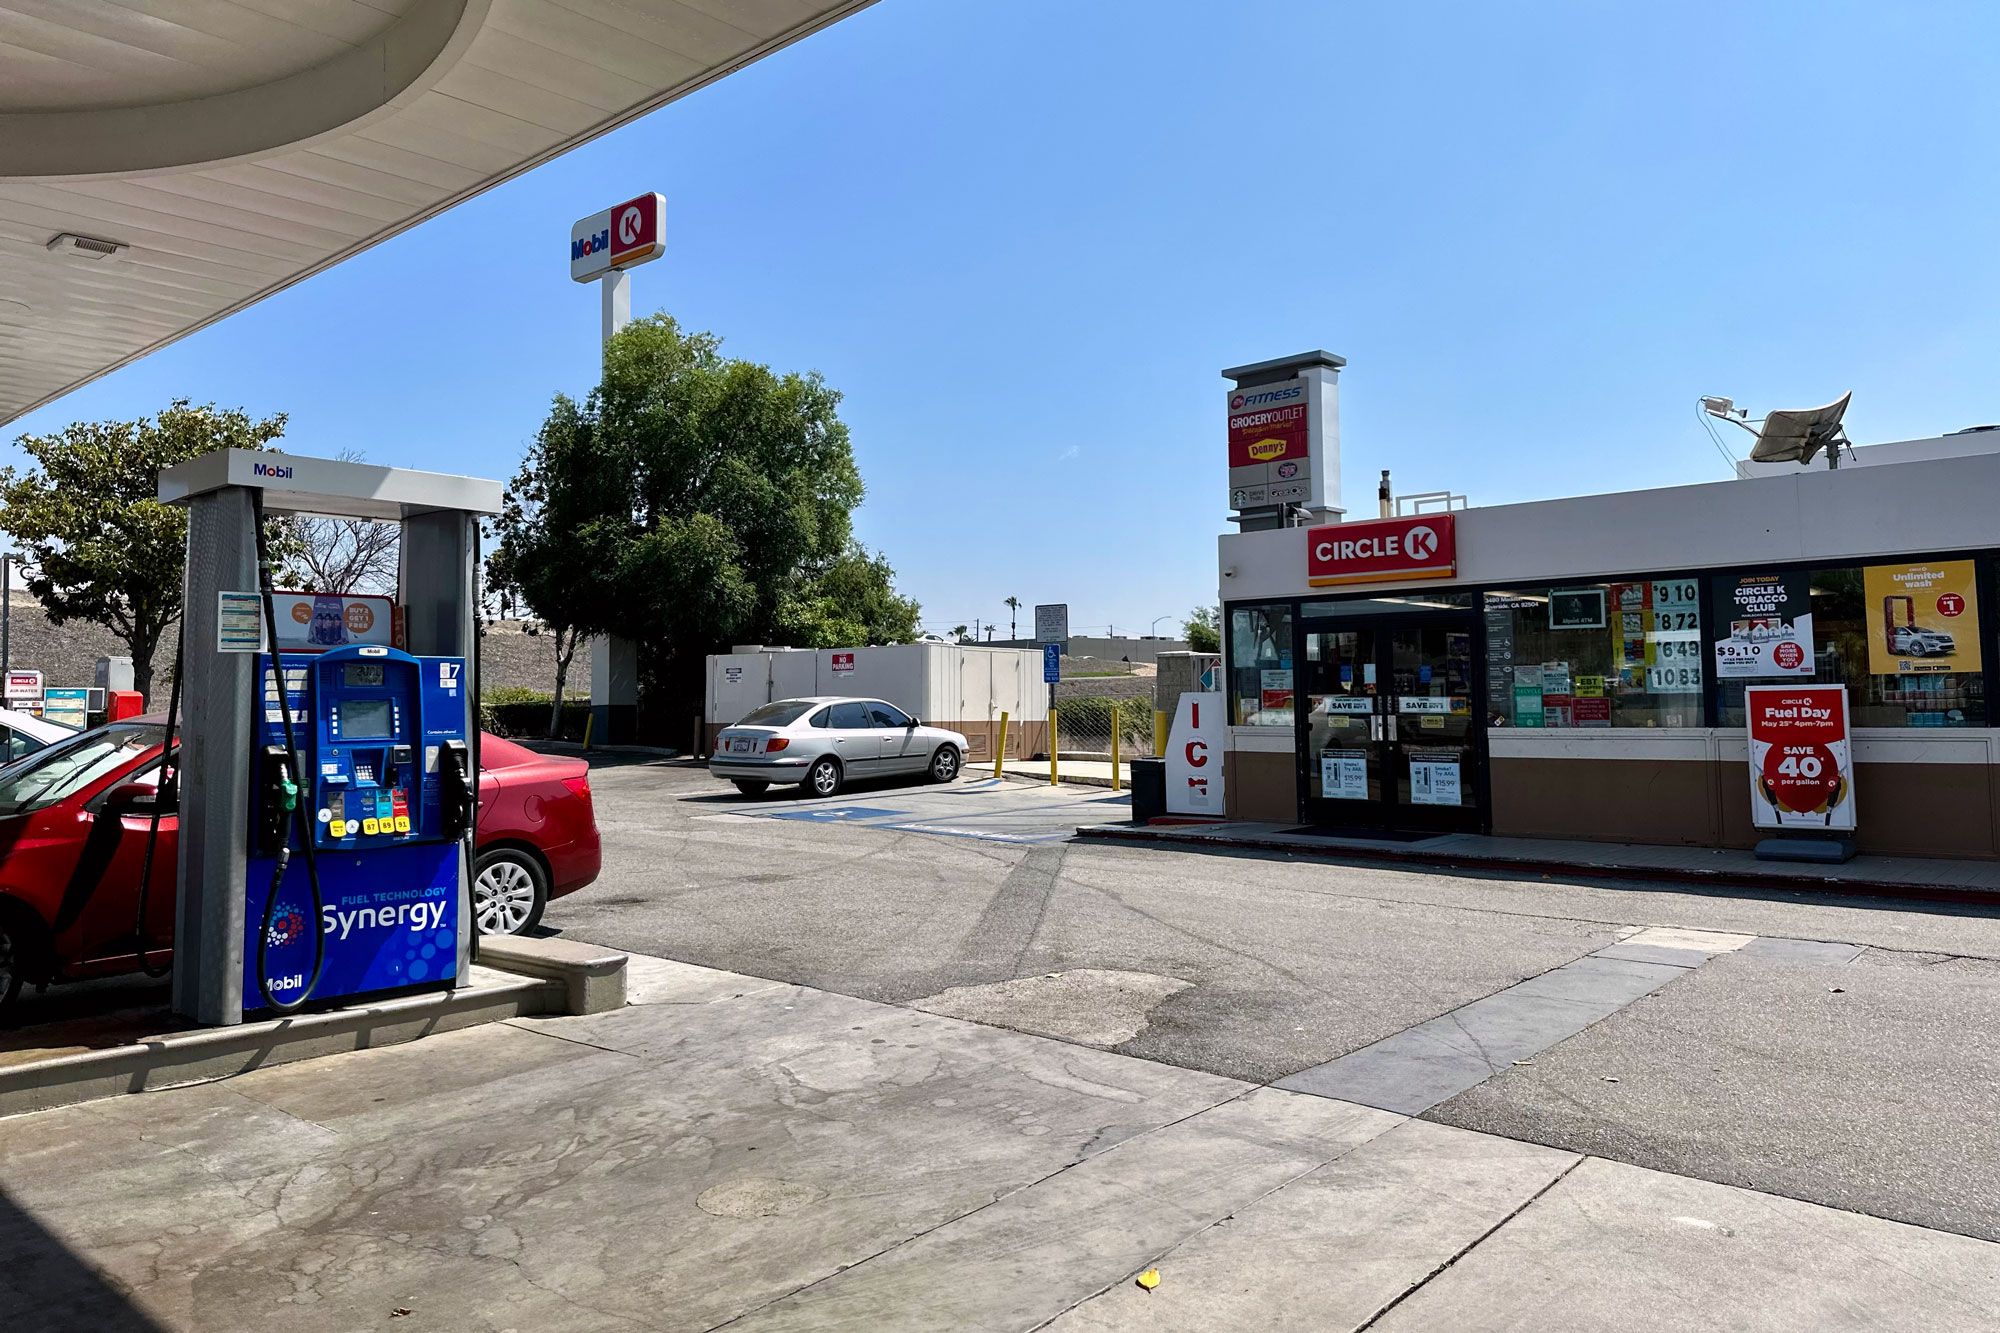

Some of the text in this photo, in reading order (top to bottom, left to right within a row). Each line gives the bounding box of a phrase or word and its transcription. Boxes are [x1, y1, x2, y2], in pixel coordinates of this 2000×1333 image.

[622, 210, 641, 242] K
[571, 229, 608, 260] Mobil
[1245, 386, 1303, 406] FITNESS
[1252, 441, 1285, 456] Denny's
[254, 463, 293, 479] Mobil
[1315, 529, 1437, 562] CIRCLE K
[1893, 571, 1945, 581] Unlimited
[1735, 585, 1786, 596] CIRCLE K
[1905, 580, 1932, 588] wash
[1733, 594, 1788, 605] TOBACCO
[1745, 603, 1776, 612] CLUB
[1717, 646, 1761, 656] $9.10
[450, 664, 461, 679] 7
[833, 662, 854, 670] PARKING
[1765, 707, 1831, 719] Fuel Day
[1783, 746, 1815, 755] SAVE
[341, 887, 447, 905] FUEL TECHNOLOGY
[322, 900, 447, 940] Synergy
